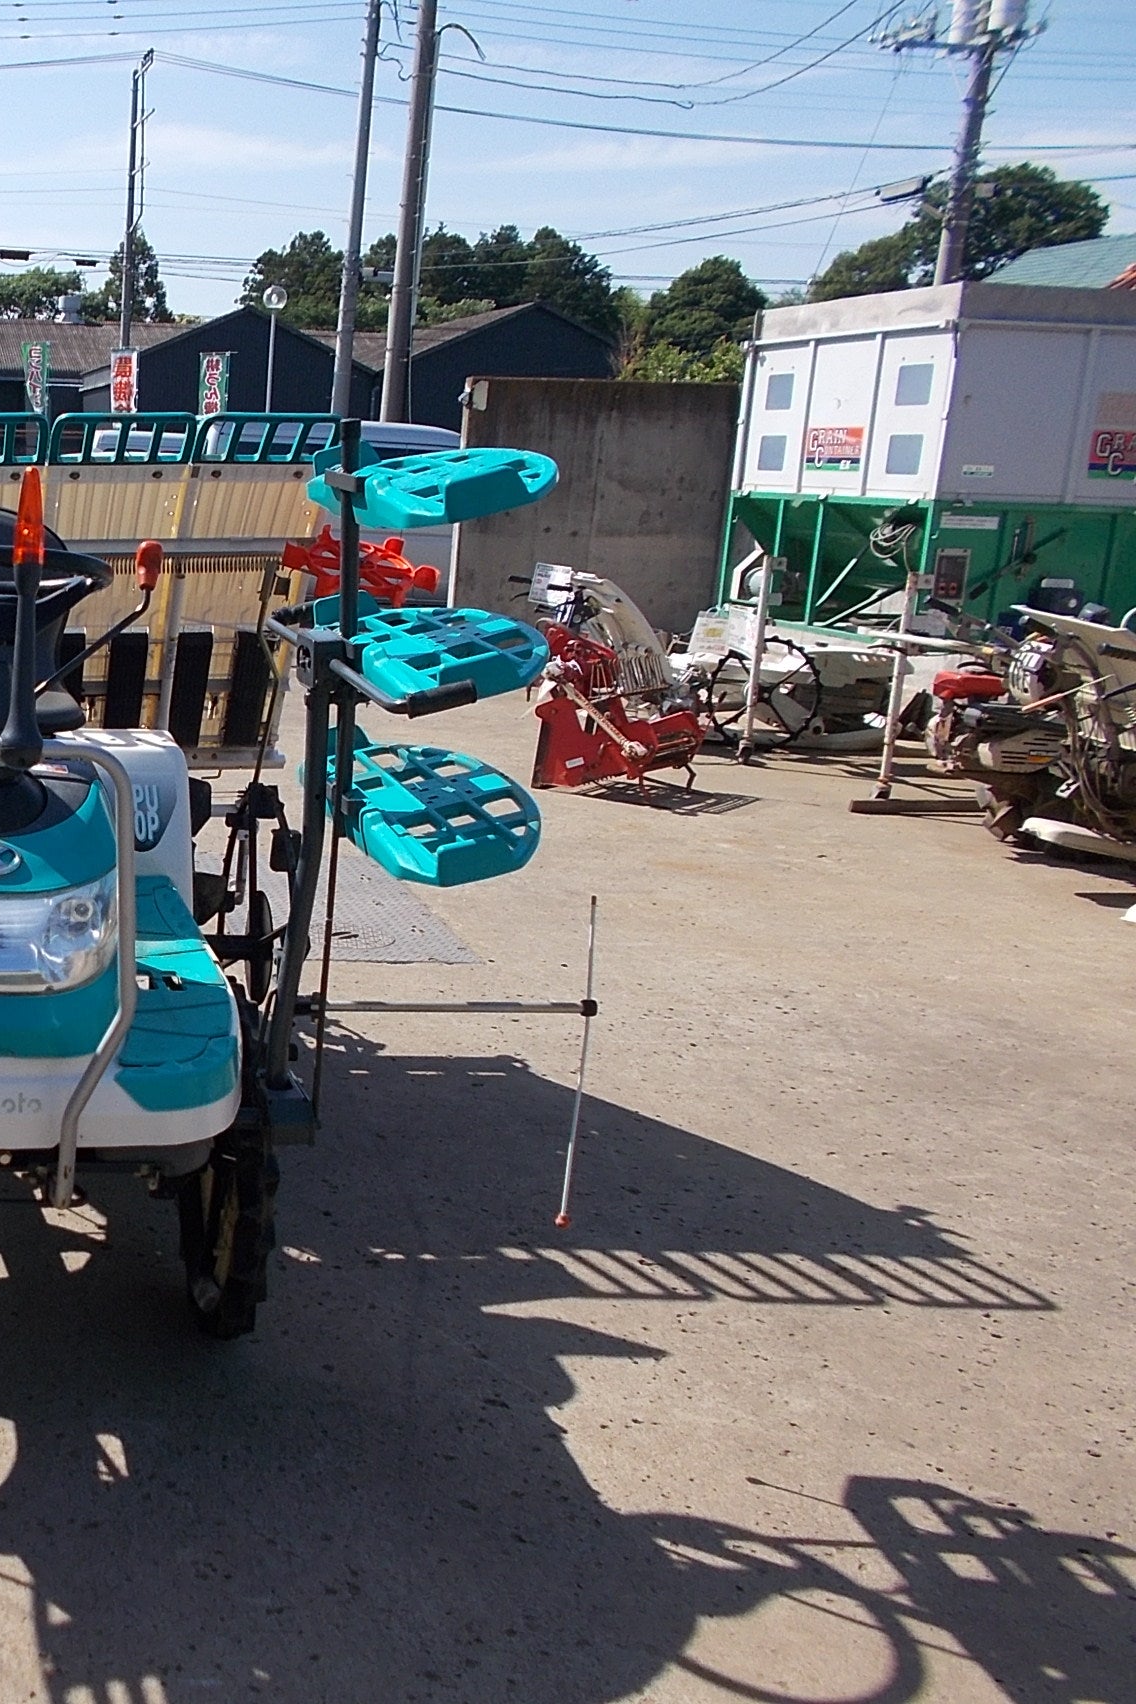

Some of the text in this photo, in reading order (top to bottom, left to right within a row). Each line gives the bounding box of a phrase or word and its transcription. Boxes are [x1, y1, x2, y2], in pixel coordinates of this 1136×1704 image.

[810, 429, 847, 451] GRAIN
[815, 446, 861, 468] CONTAINER
[133, 784, 160, 812] PU
[134, 810, 161, 842] 0P
